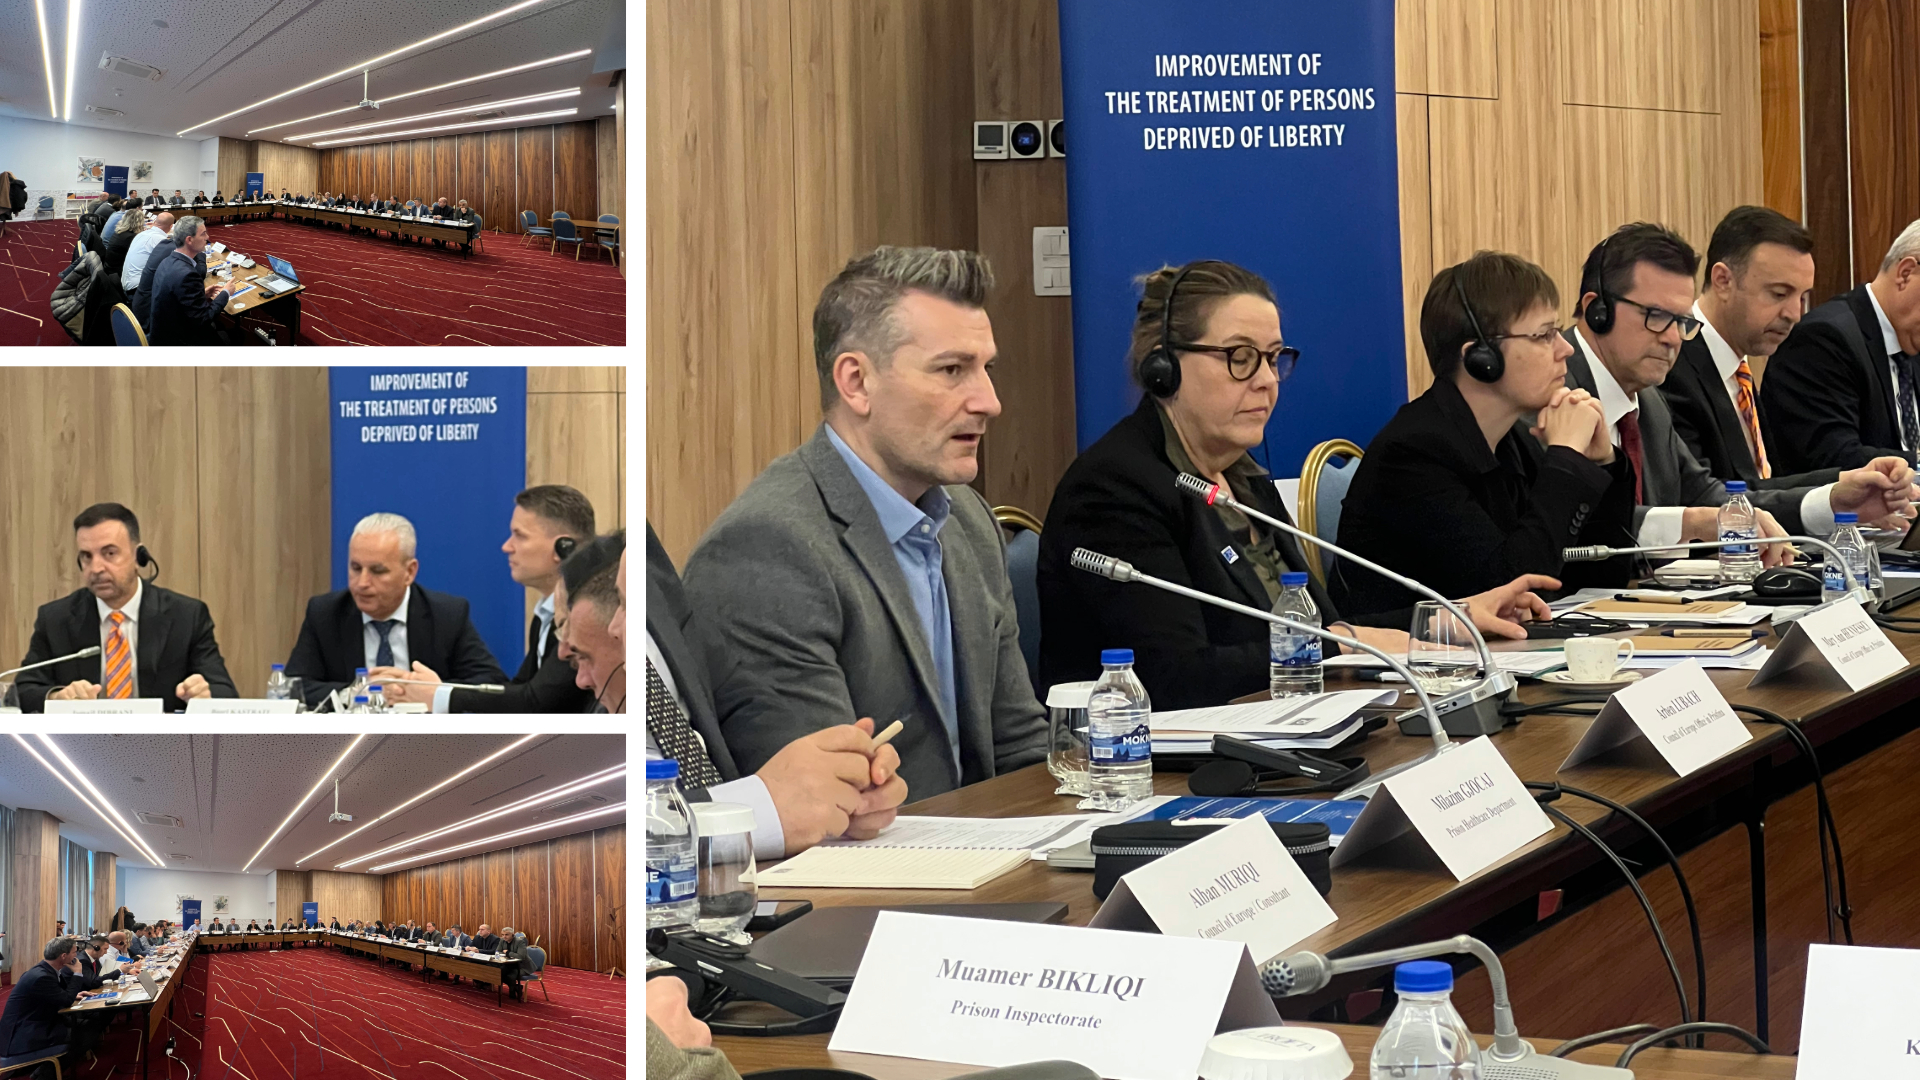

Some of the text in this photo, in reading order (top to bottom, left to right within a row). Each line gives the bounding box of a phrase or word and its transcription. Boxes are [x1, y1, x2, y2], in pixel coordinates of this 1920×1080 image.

[1155, 53, 1322, 77] IMPROVEMENT OF
[1105, 88, 1376, 114] THE TREATMENT OF PERSONS
[1144, 124, 1345, 150] DEPRIVED OF LIBERTY
[370, 371, 469, 391] IMPROVEMENT OF
[340, 397, 497, 417] THE TREATMENT OF PERSONS
[361, 423, 479, 443] DEPRIVED OF LIBERTY
[1656, 690, 1701, 720] Arben LUBACH
[1430, 772, 1494, 812] Milazim GJOCAJ
[1446, 797, 1517, 838] Prison Healthcare Department
[1188, 861, 1260, 908] Alban MURIQI
[1255, 887, 1291, 911] Consultant
[1225, 914, 1234, 928] of
[1229, 906, 1256, 924] Europe
[1197, 919, 1226, 939] Council
[936, 958, 1147, 1002] Muamer BIKLIQI
[950, 999, 1102, 1029] Prison Inspectorate
